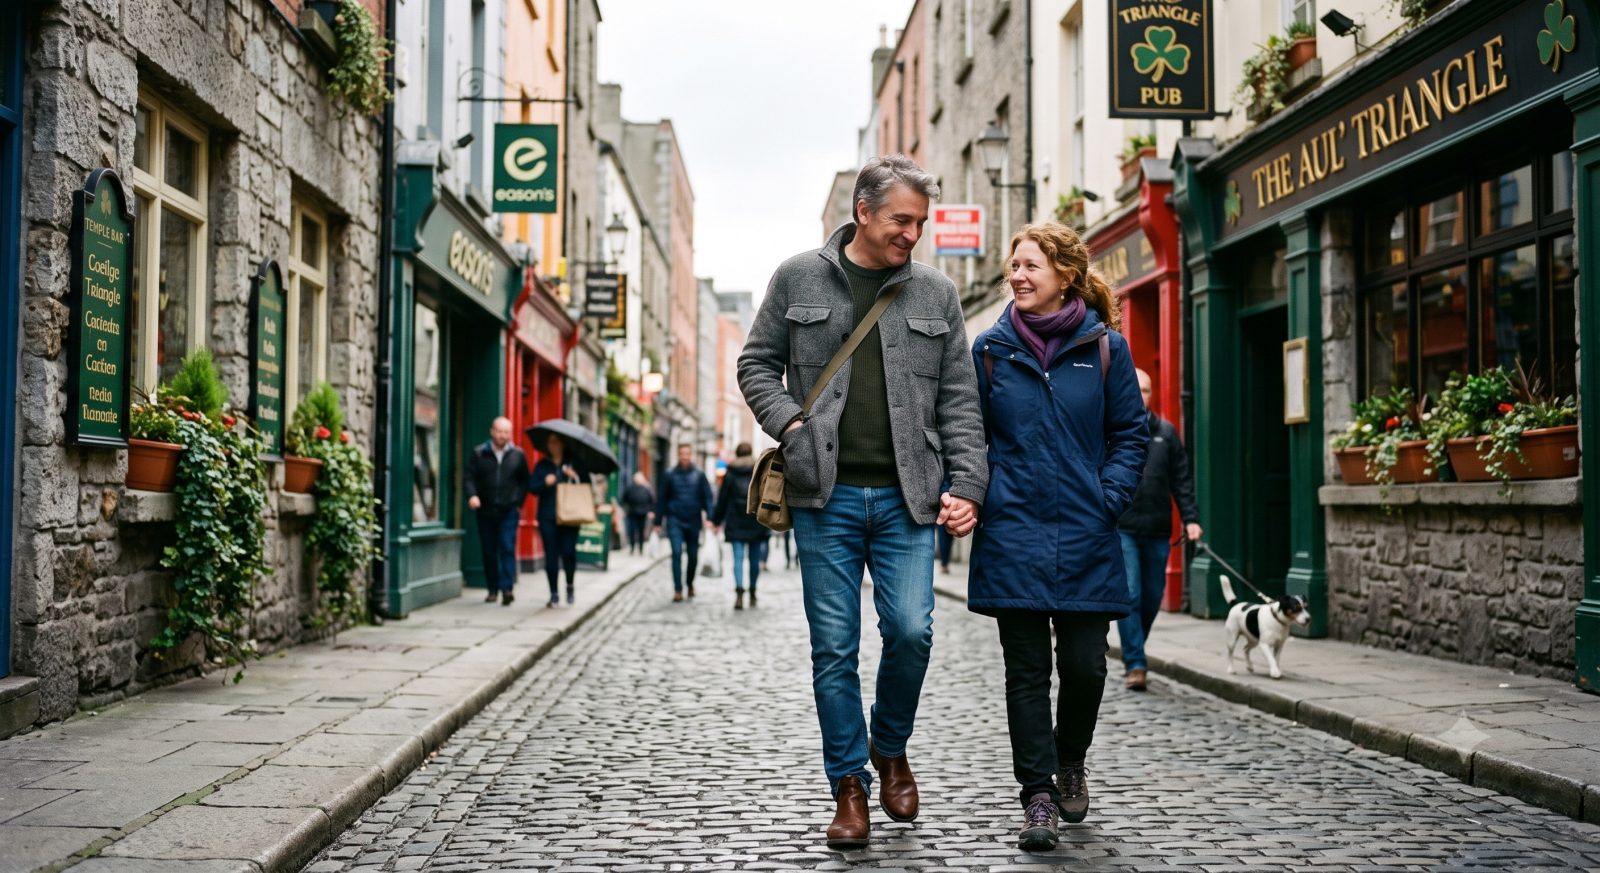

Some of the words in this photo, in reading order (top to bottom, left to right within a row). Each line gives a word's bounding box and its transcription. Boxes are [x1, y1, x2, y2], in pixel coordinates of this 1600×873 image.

[1118, 4, 1202, 26] TRIANGLE
[1140, 86, 1182, 105] PUB
[1251, 151, 1295, 210] THE
[1350, 34, 1508, 160] TRIANGLE
[494, 187, 555, 201] eason's
[84, 217, 110, 239] TEMPLE
[111, 228, 124, 245] BAR
